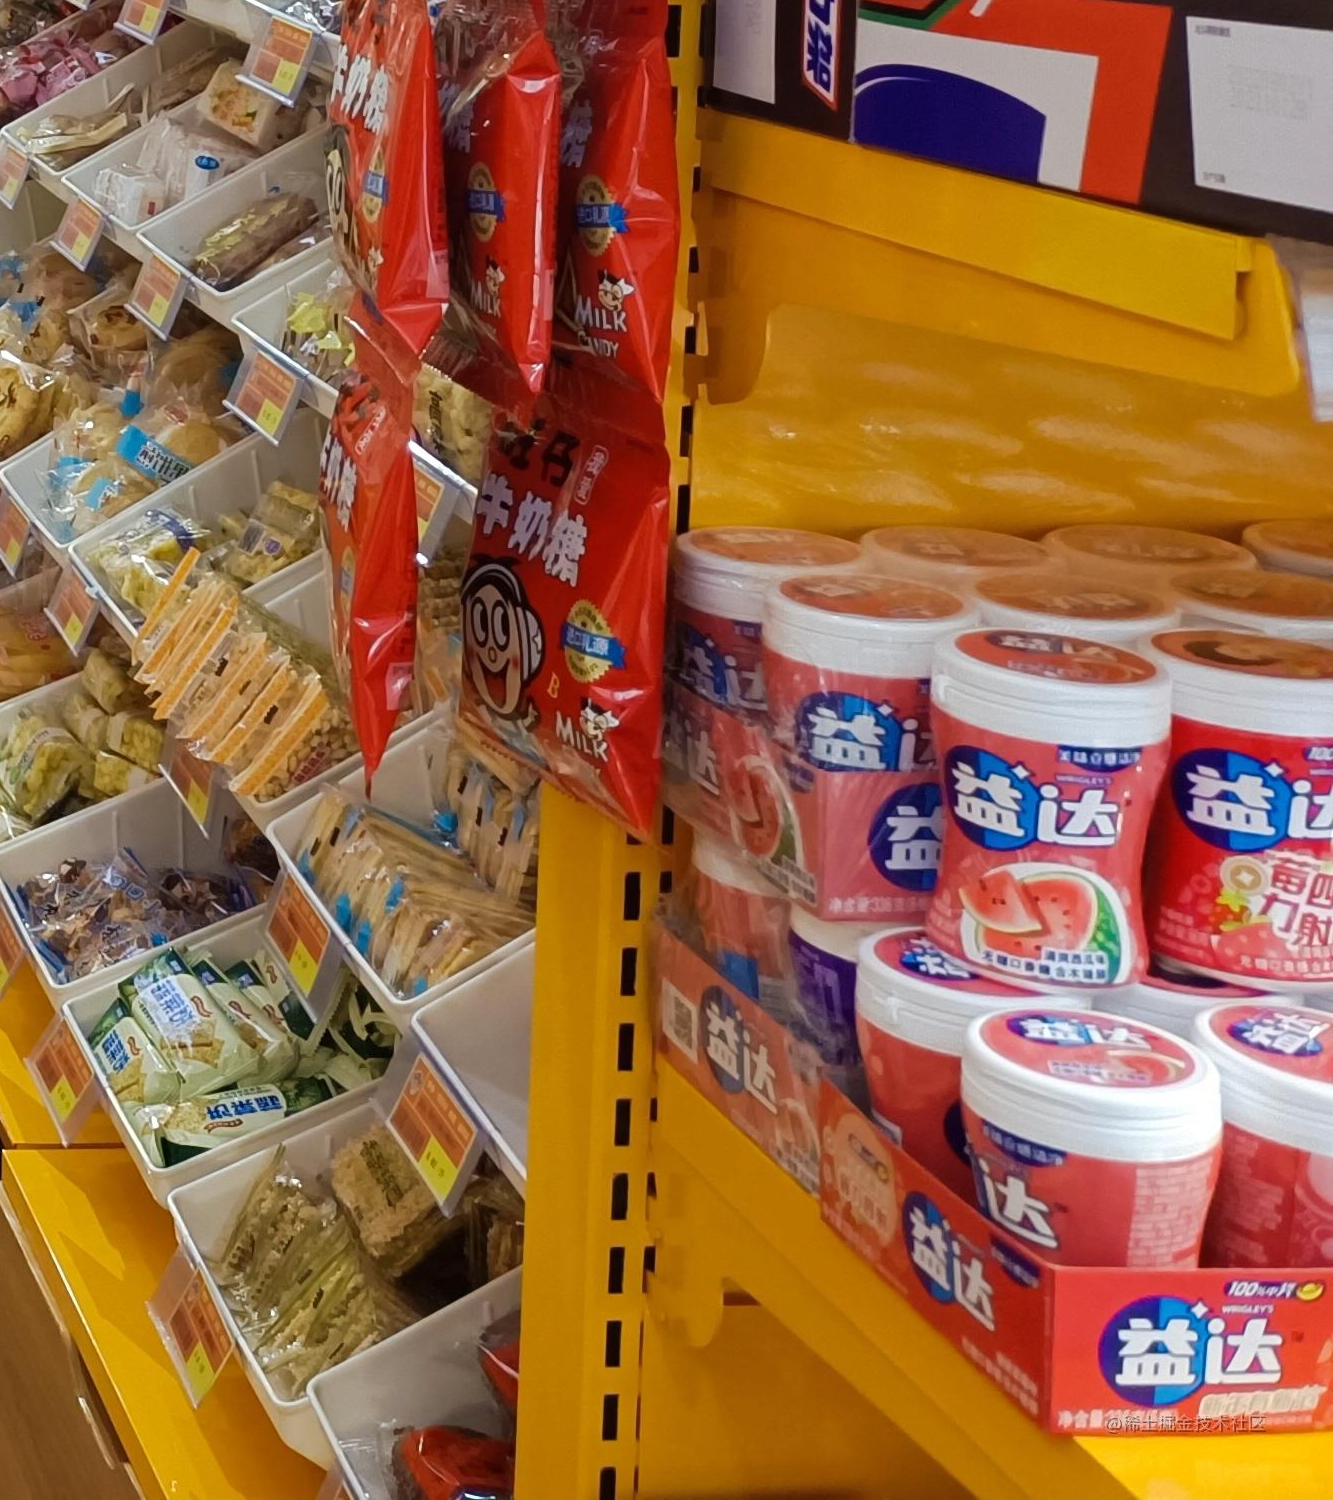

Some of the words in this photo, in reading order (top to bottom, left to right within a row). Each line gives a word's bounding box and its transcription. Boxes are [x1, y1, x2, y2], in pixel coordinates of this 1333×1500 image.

[574, 295, 629, 333] MILK
[475, 472, 588, 588] 牛奶糖
[555, 712, 610, 763] MILK
[950, 761, 1119, 847] 益达
[705, 1002, 778, 1116] 益达
[909, 1205, 997, 1333] 益达
[1115, 1317, 1284, 1386] 益达
